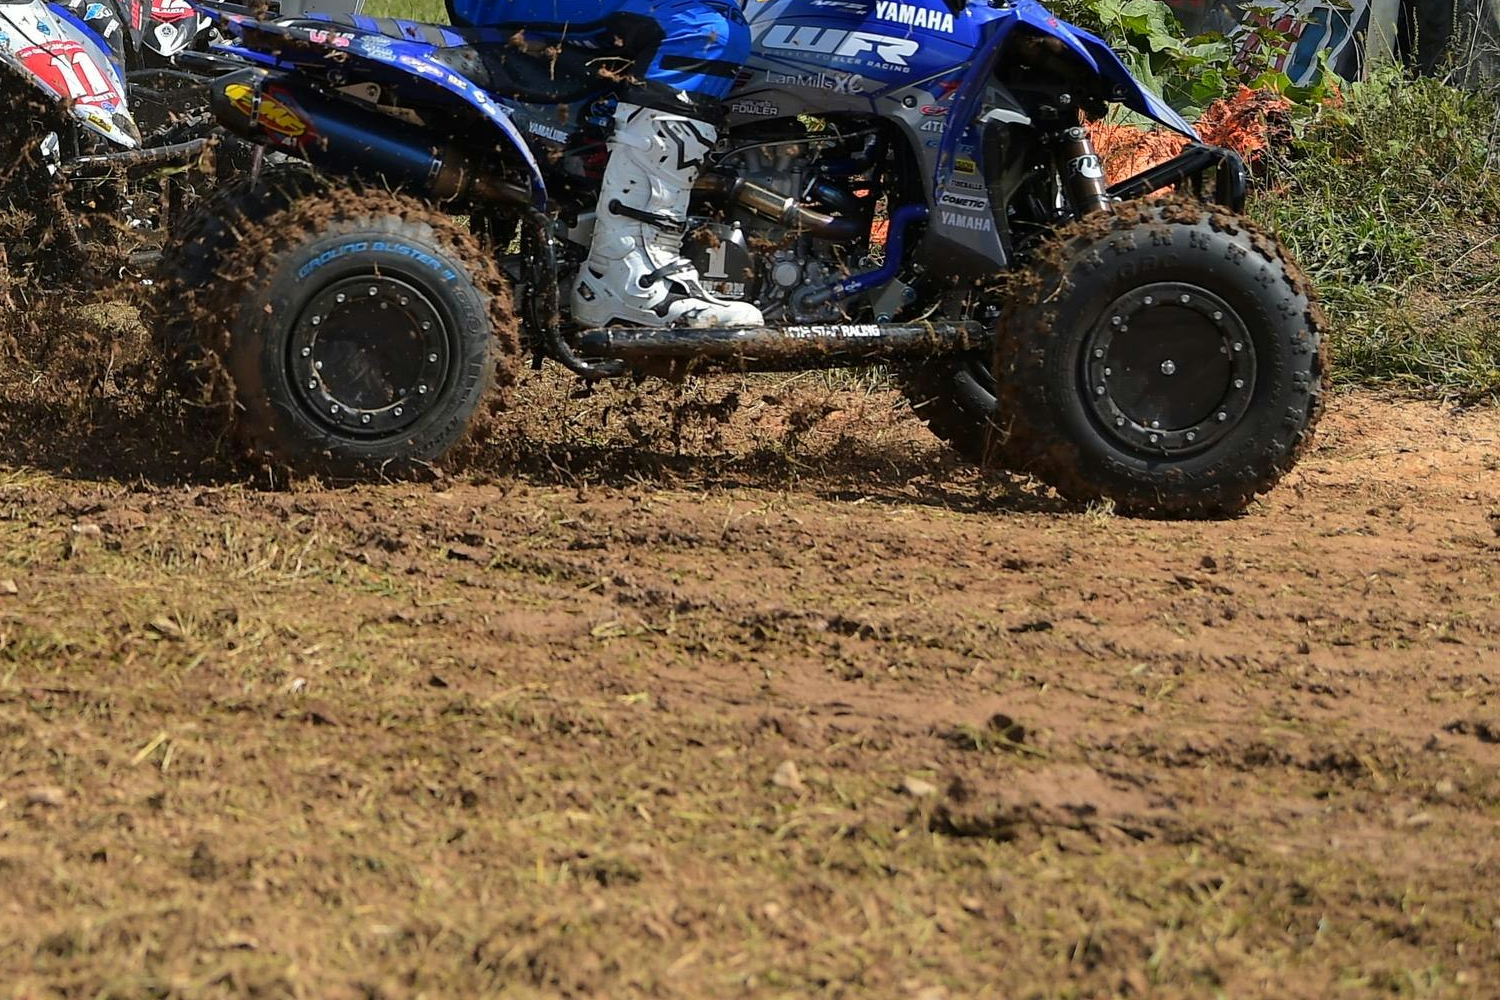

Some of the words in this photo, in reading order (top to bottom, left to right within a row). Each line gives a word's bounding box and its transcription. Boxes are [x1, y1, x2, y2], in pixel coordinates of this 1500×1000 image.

[875, 0, 954, 34] YAMAHA
[49, 51, 111, 99] 11
[867, 61, 911, 74] RACING
[731, 103, 779, 116] FOWLER
[941, 194, 986, 209] COMETIC
[941, 210, 992, 232] YAMAHA
[297, 241, 369, 281] GROUND
[372, 240, 442, 271] BUSTER
[842, 325, 881, 338] RACING
